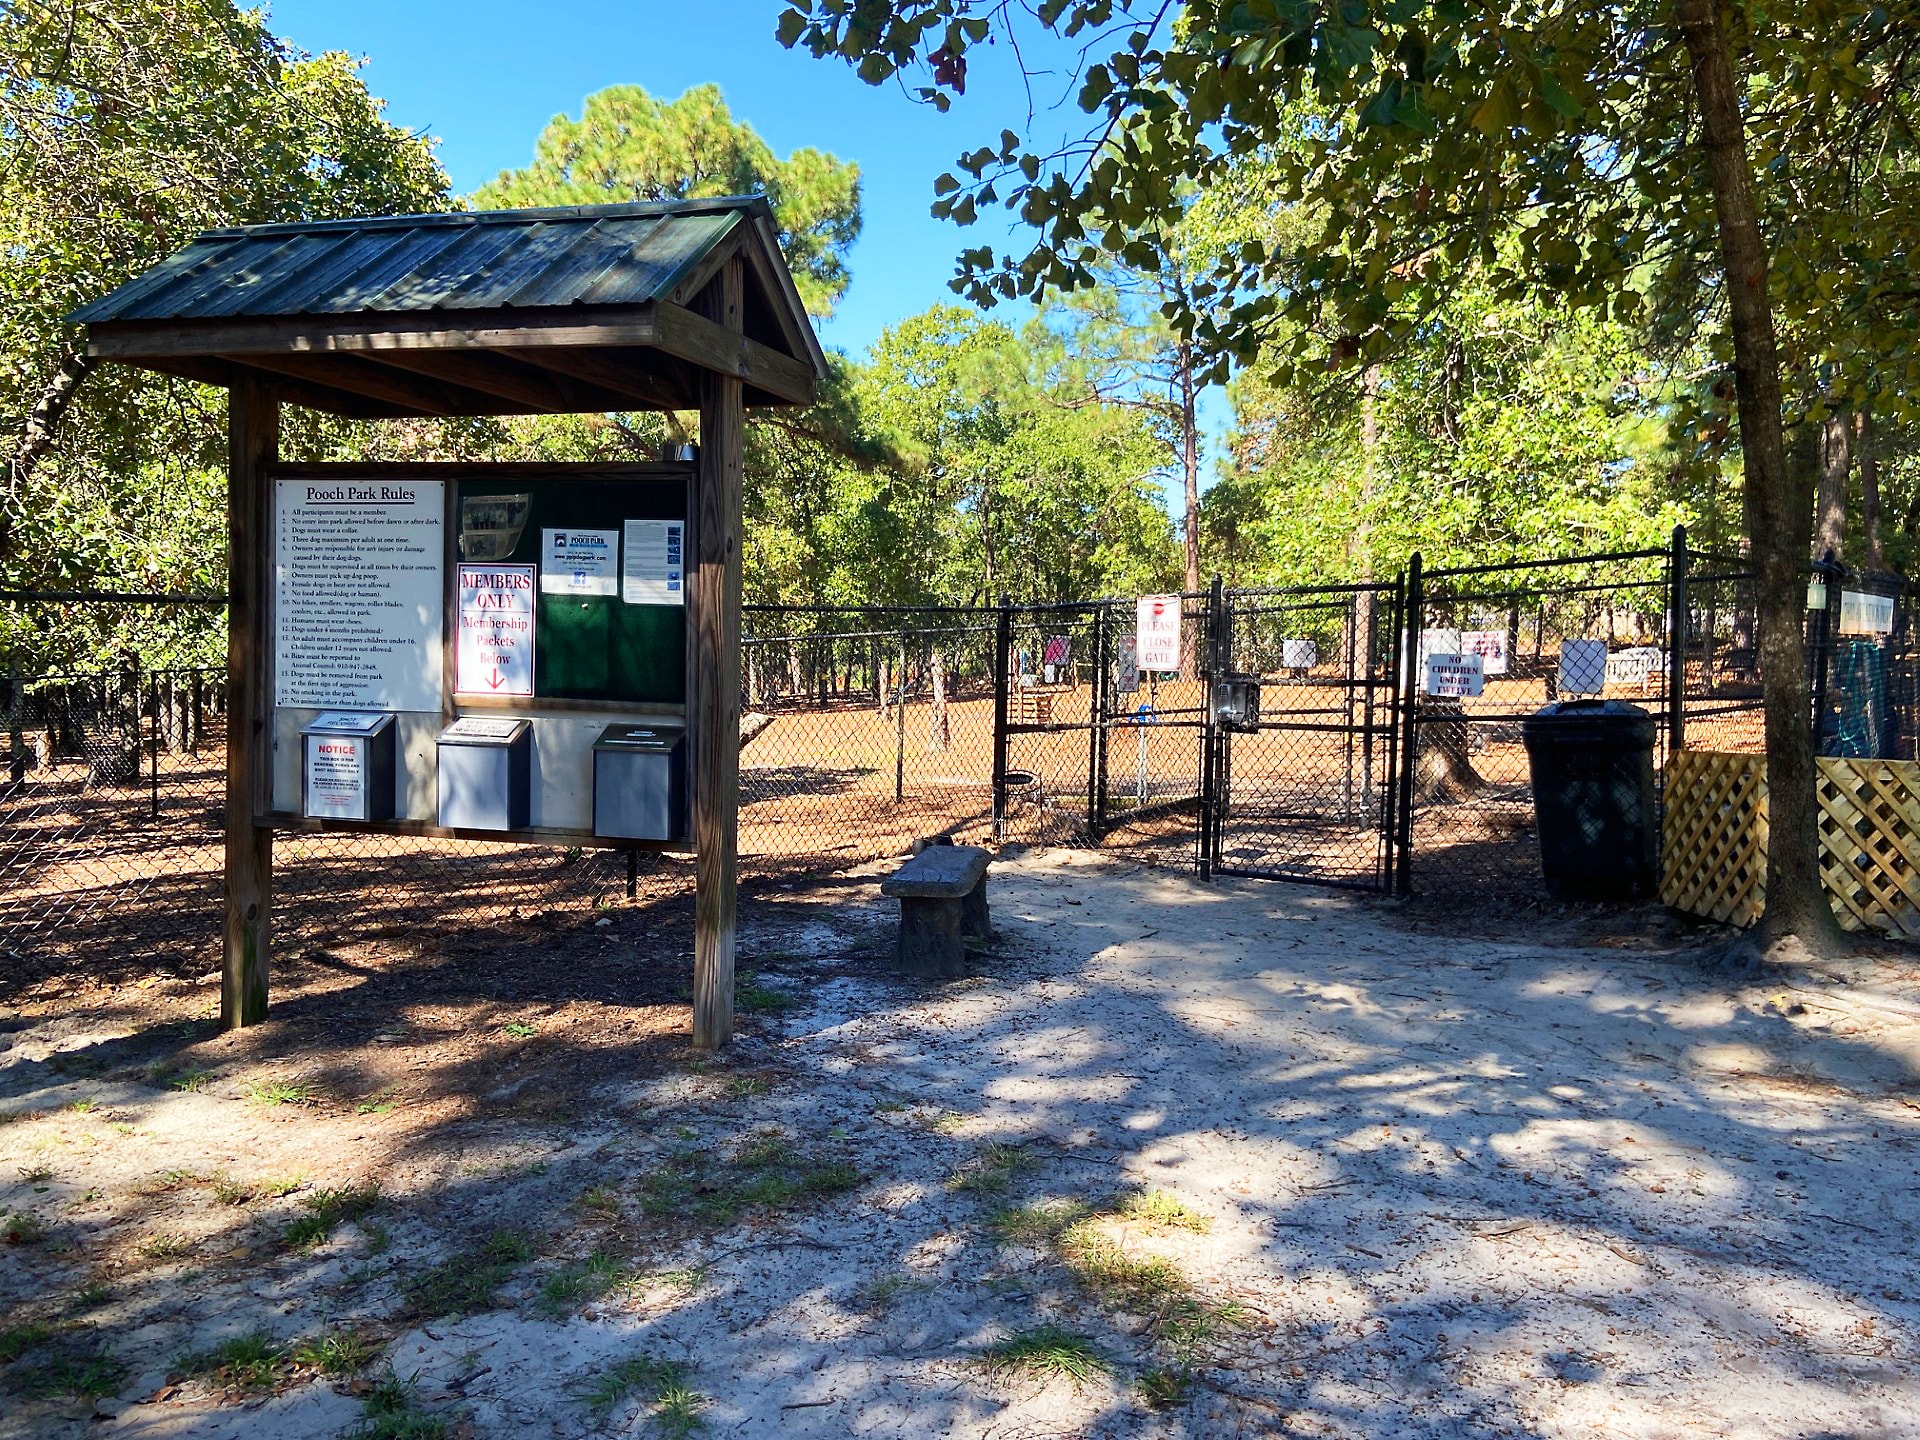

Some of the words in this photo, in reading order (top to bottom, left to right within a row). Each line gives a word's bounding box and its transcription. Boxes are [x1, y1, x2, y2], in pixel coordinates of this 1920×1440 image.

[307, 487, 344, 499] Pooch
[348, 487, 376, 499] Park
[381, 487, 415, 499] Rules
[591, 537, 605, 545] PARK
[462, 574, 530, 589] MEMBERS
[477, 593, 515, 609] ONLY
[463, 616, 528, 632] Membership
[1142, 621, 1176, 631] PLEASE
[476, 634, 515, 647] Packets
[1143, 637, 1173, 647] CLOSE
[480, 652, 511, 665] Below
[1145, 652, 1170, 663] GATE
[1448, 656, 1462, 664] NO
[1432, 666, 1478, 675] CHILDREN
[1440, 676, 1470, 684] UNDER
[1437, 687, 1473, 695] TWELVE
[318, 745, 355, 754] NOTICE
